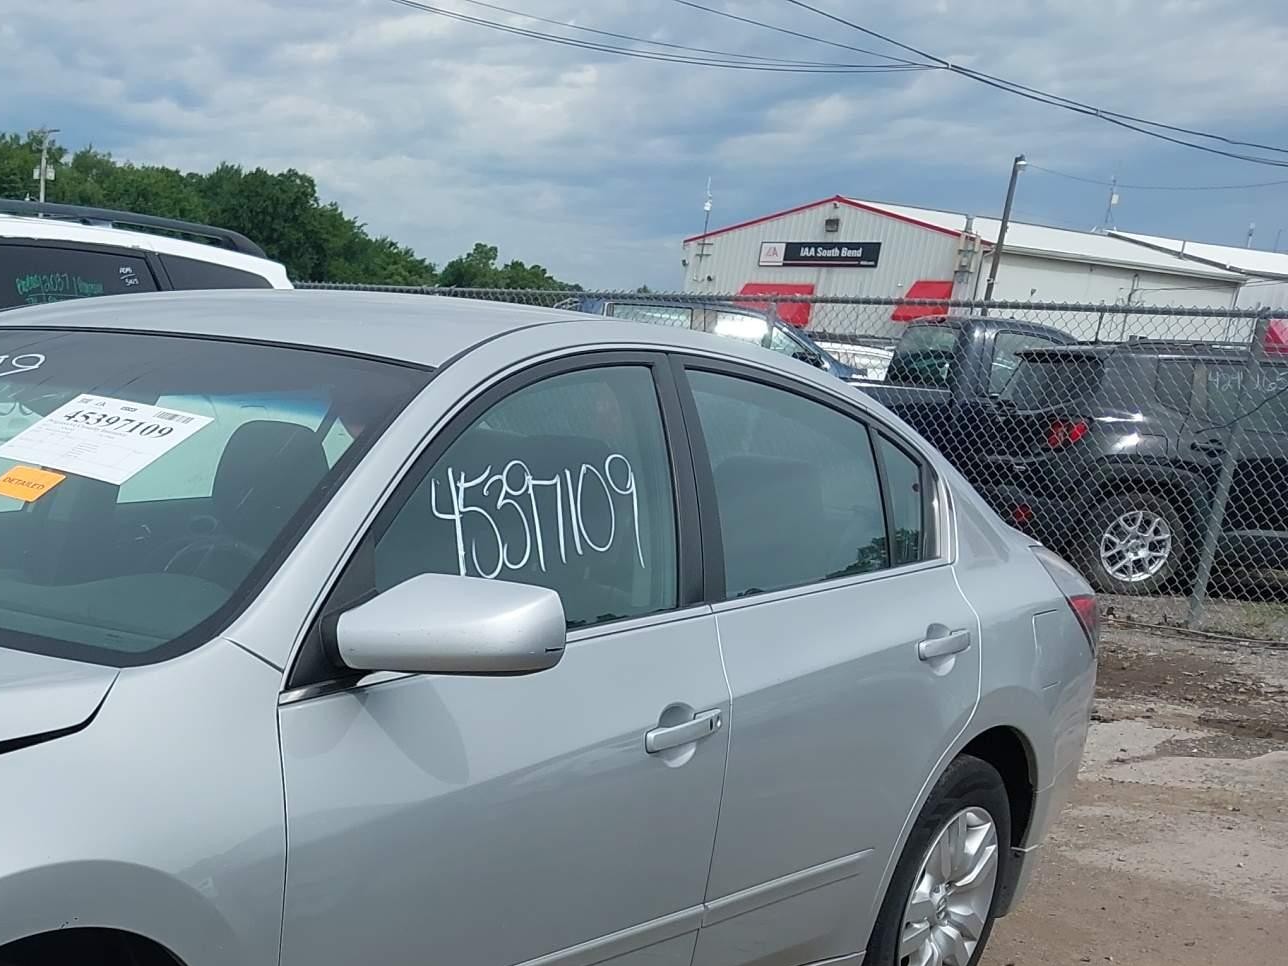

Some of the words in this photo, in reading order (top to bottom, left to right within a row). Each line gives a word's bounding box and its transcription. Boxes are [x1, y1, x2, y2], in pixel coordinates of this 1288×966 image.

[800, 247, 815, 257] IAA
[816, 247, 839, 257] South
[840, 247, 863, 257] Bend
[64, 409, 174, 439] 45397109
[431, 453, 645, 579] 45397109
